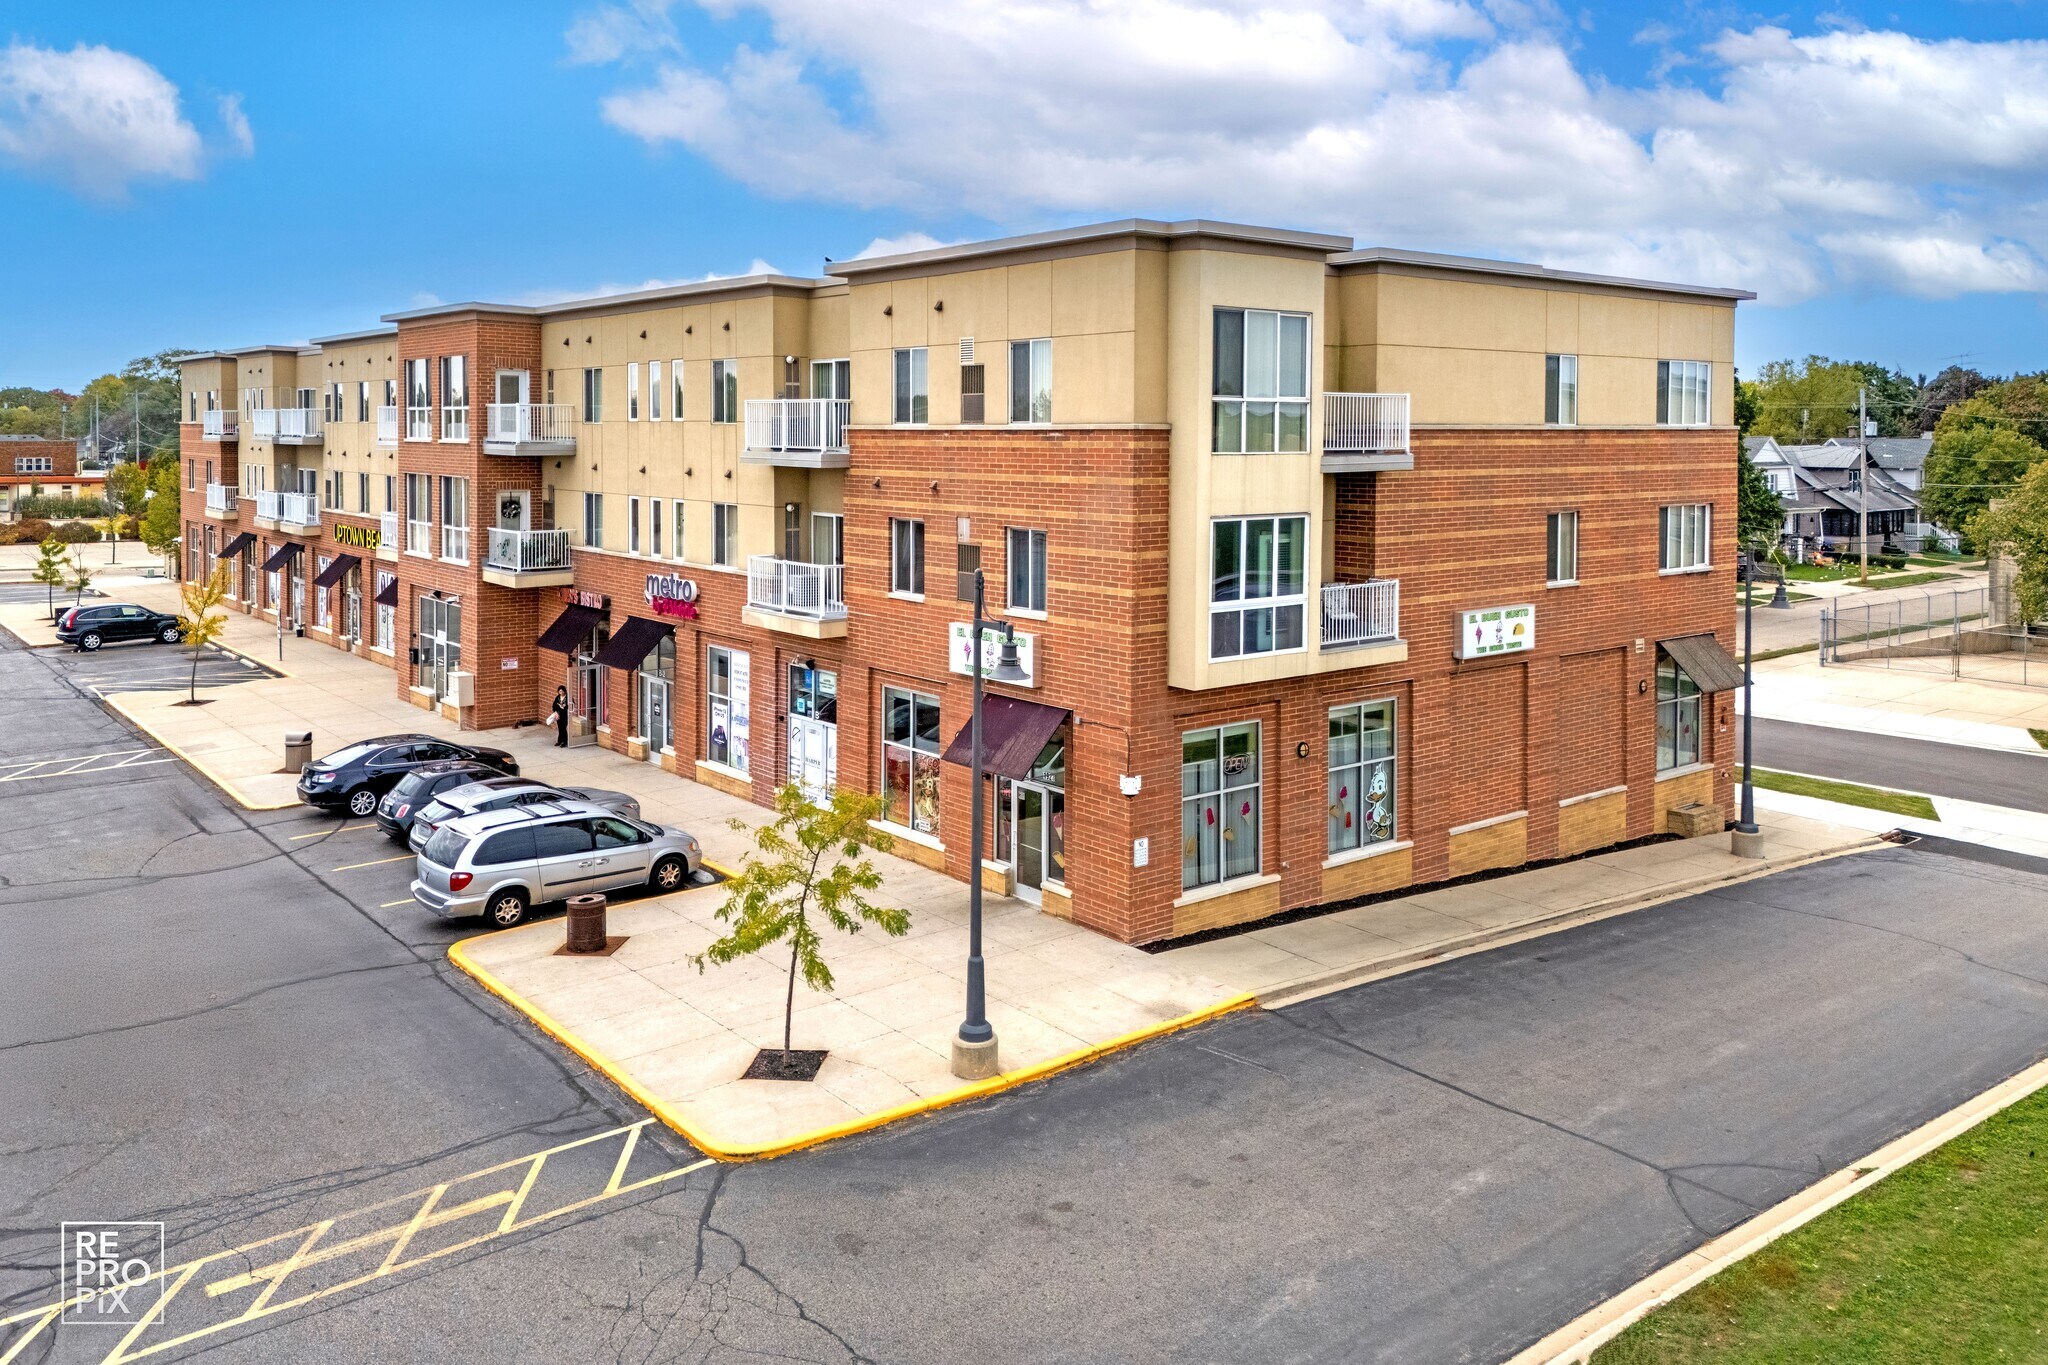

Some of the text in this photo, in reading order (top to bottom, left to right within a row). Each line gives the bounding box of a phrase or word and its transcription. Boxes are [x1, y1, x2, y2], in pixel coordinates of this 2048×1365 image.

[333, 523, 365, 548] UPTOWN
[645, 573, 692, 603] metro
[1469, 608, 1529, 624] EL BUEN GUSTO
[956, 626, 967, 638] EL
[1225, 757, 1248, 771] OPEN
